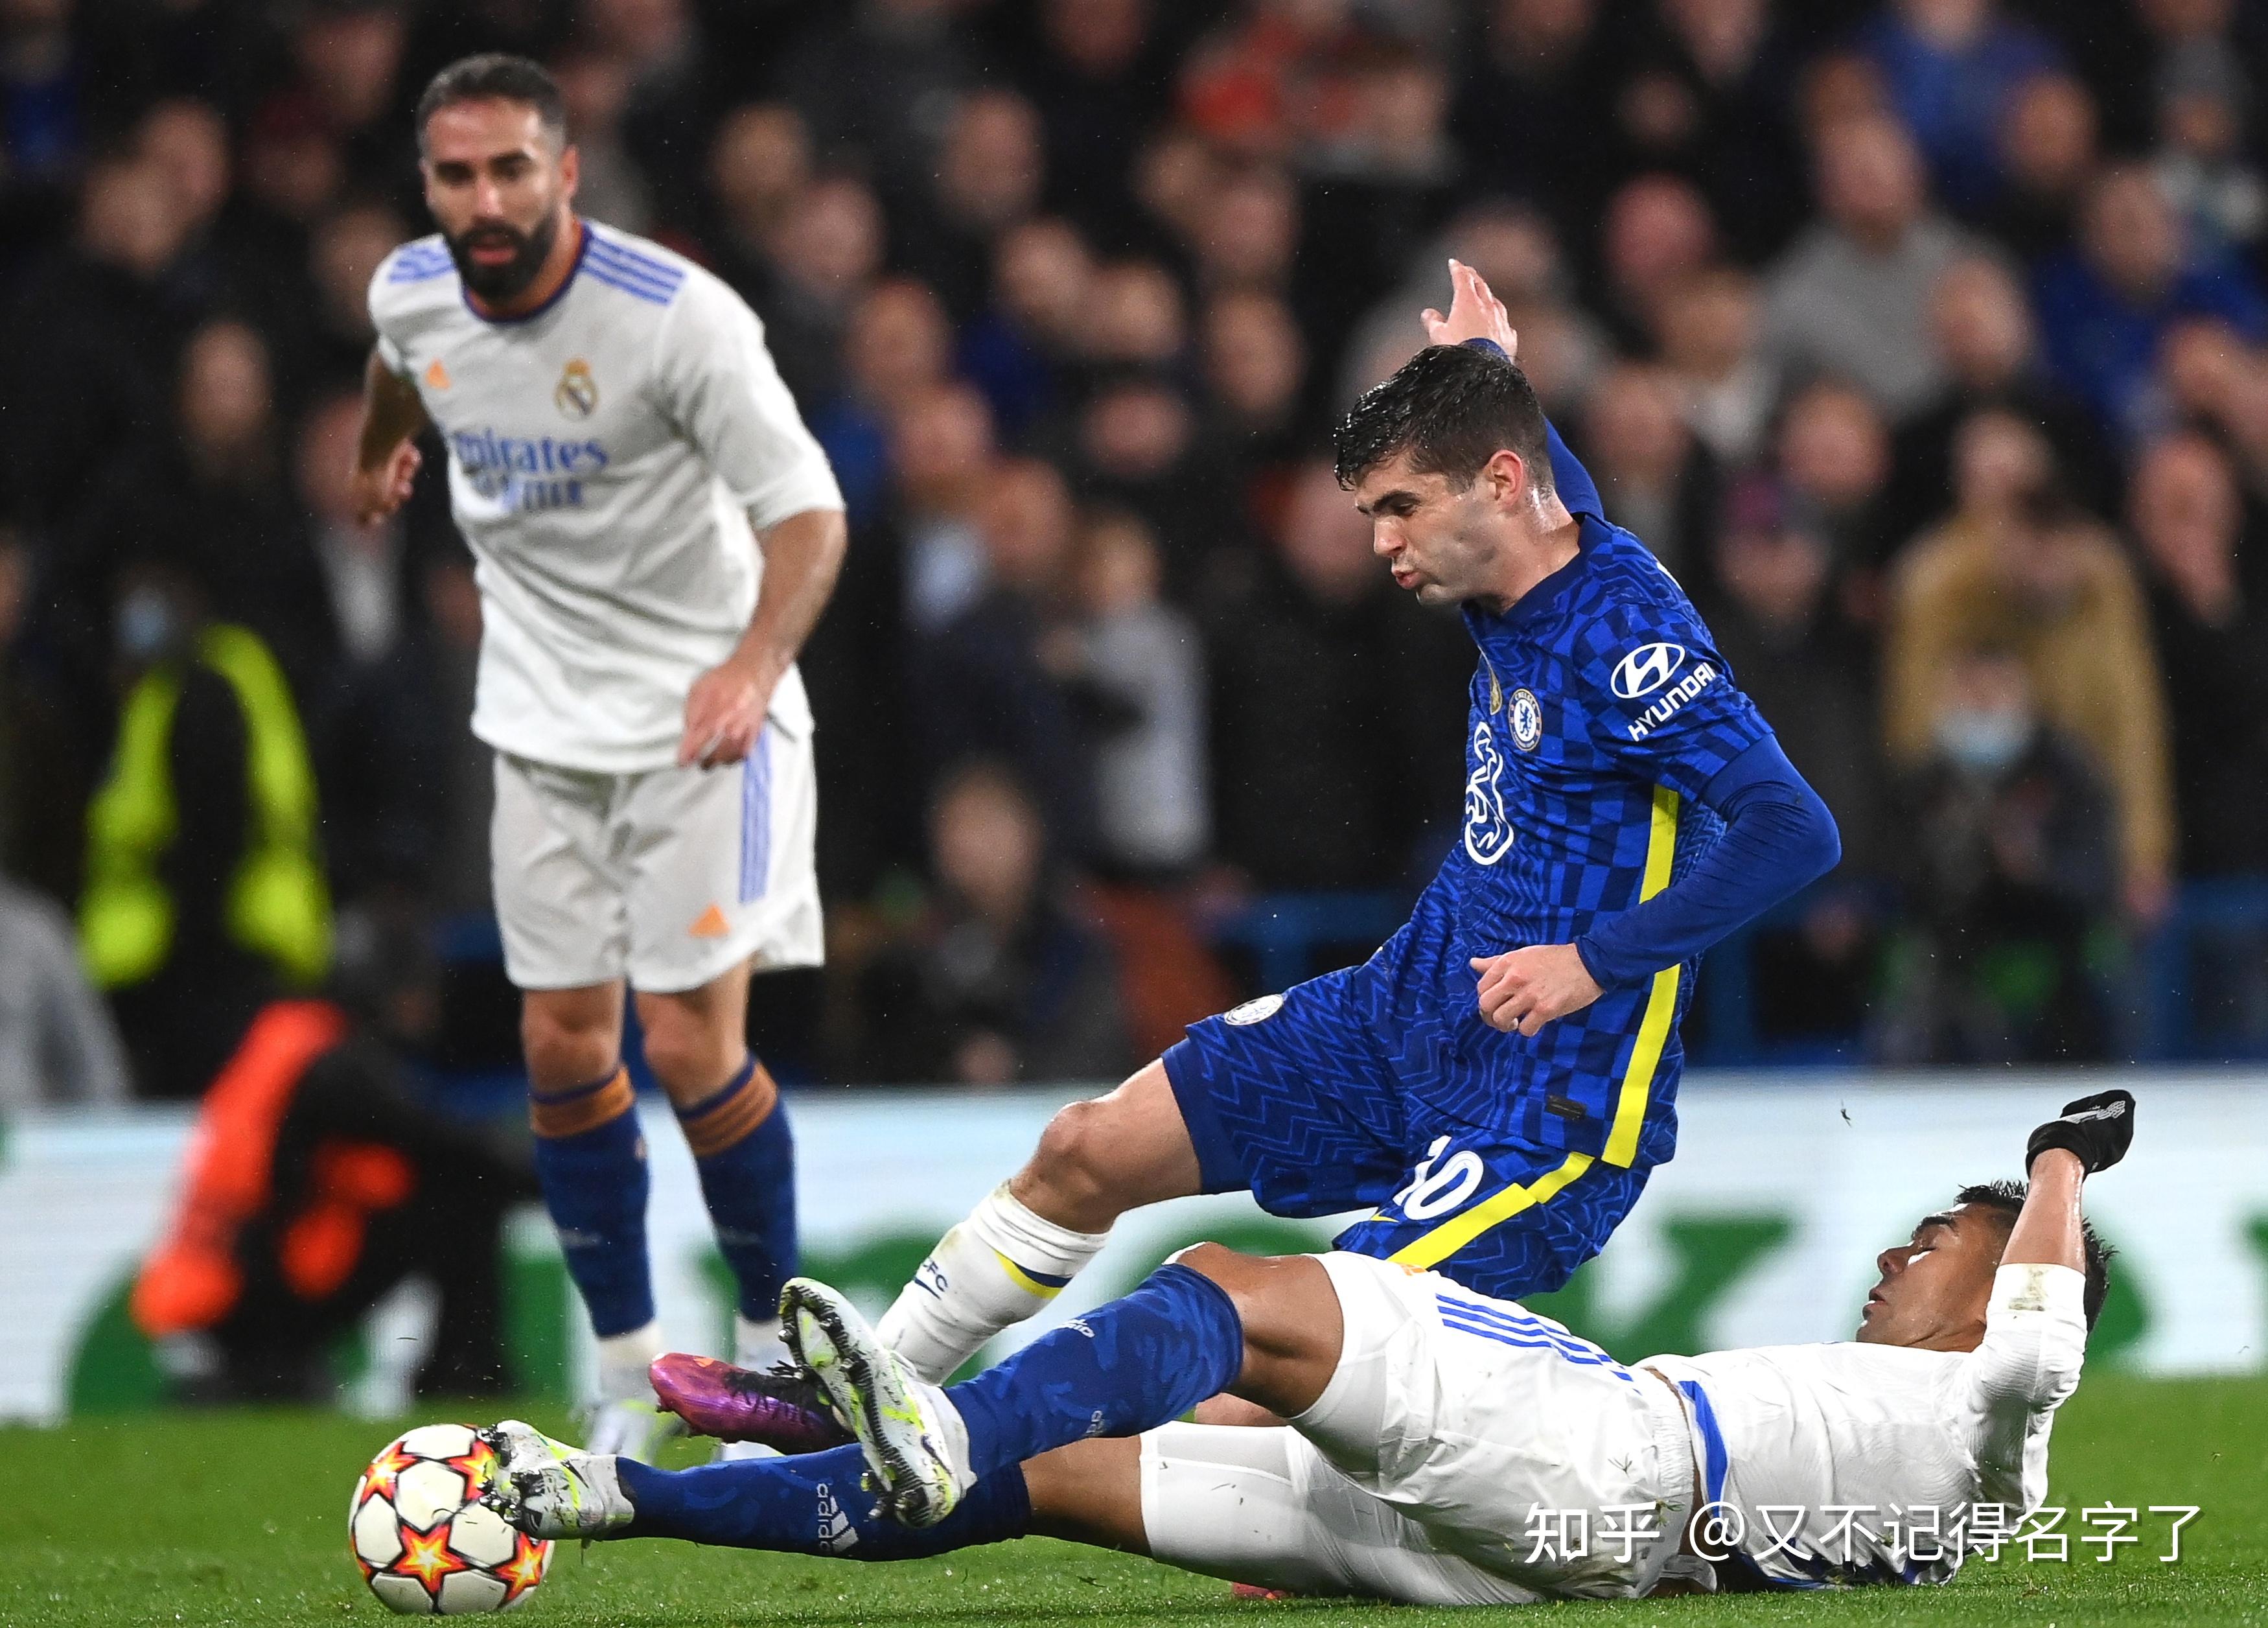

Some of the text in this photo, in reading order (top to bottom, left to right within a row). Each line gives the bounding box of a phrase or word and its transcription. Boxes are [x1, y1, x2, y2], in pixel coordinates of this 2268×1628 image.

[454, 426, 610, 474] mirates
[1627, 662, 1717, 742] HYUNDAI
[1393, 1135, 1484, 1220] 10
[816, 1482, 834, 1552] adida
